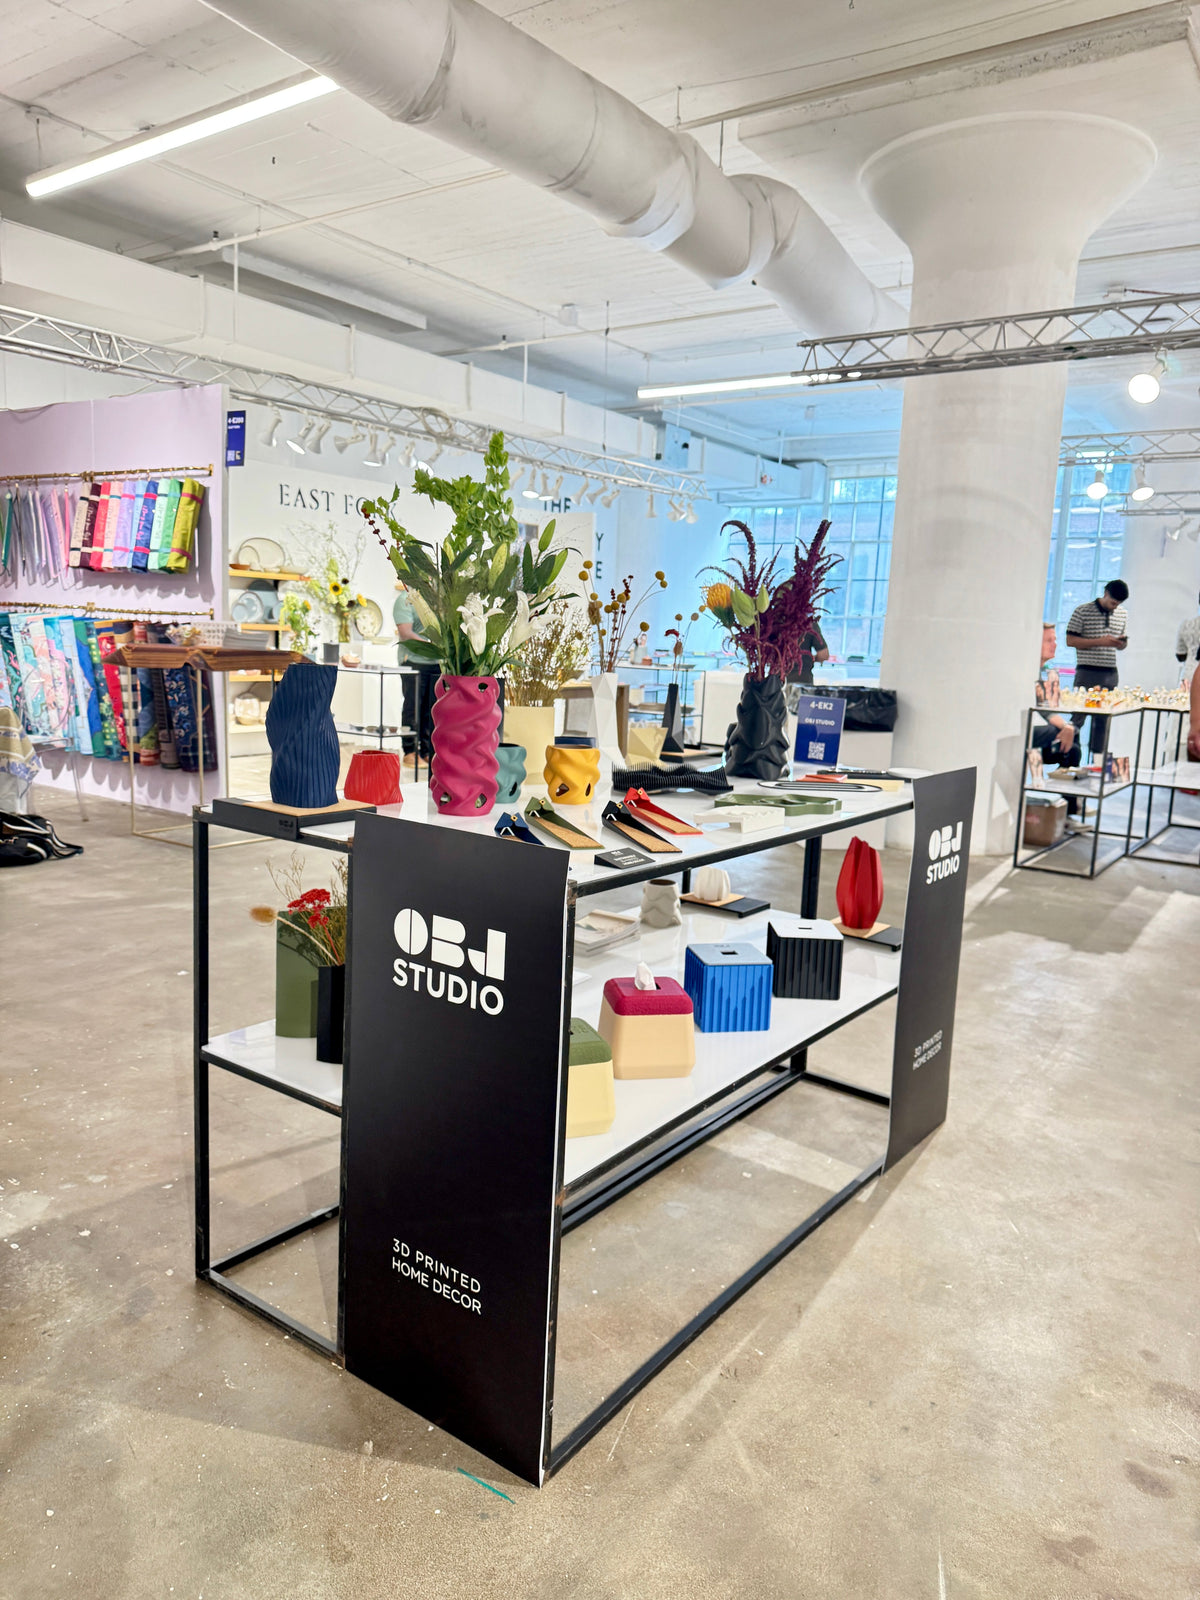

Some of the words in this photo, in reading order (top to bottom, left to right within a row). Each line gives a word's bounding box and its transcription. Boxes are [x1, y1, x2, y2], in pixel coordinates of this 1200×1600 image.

[280, 484, 335, 512] EAST
[809, 701, 834, 711] 4-EK2
[815, 718, 836, 727] STUDIO
[928, 821, 963, 861] OBJ
[926, 854, 960, 885] STUDIO
[393, 908, 507, 981] OBJ
[392, 958, 504, 1016] STUDIO
[912, 1052, 927, 1071] HOME
[927, 1041, 942, 1060] DECOR
[914, 1045, 921, 1058] 3D
[922, 1029, 943, 1053] PRINTED
[393, 1237, 410, 1257] 3D
[415, 1249, 481, 1293] PRINTED
[392, 1256, 430, 1289] HOME
[432, 1278, 482, 1315] DECOR
